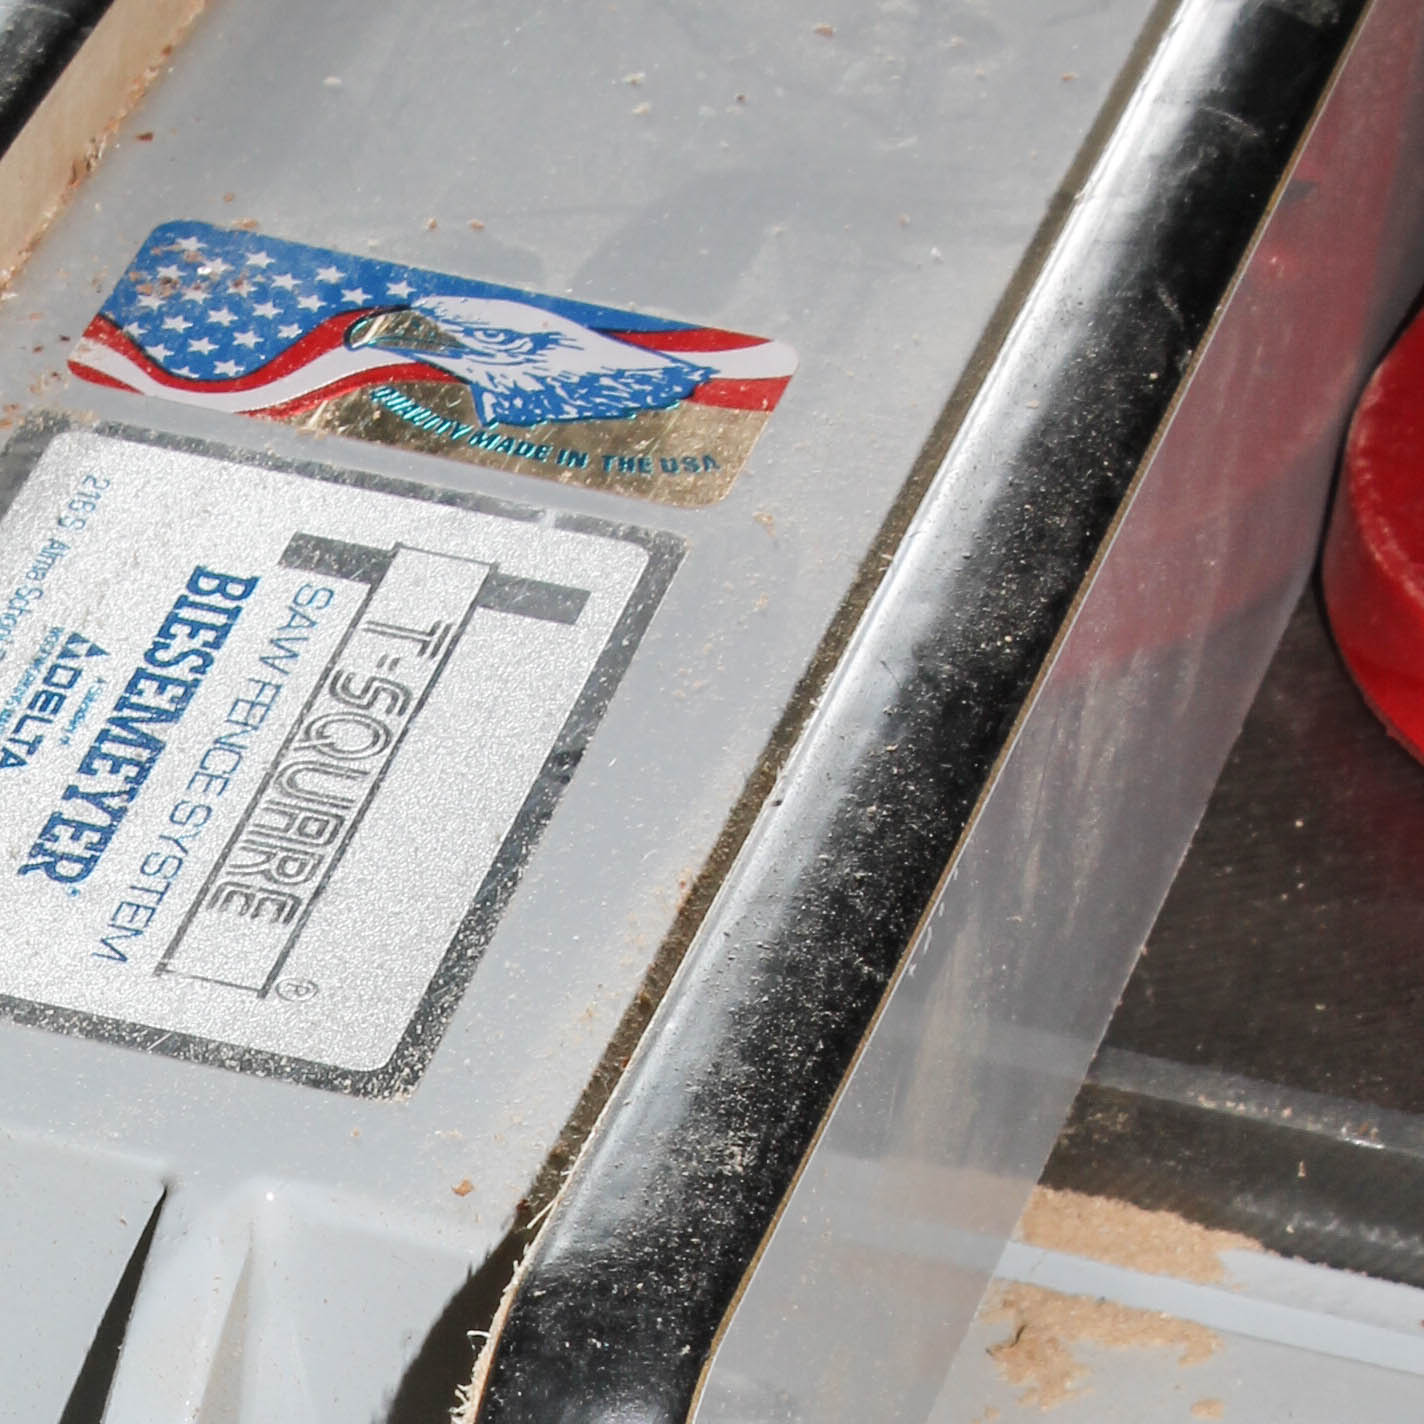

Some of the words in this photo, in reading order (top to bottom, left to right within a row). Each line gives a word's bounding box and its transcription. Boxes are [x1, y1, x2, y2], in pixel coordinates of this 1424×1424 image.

[64, 473, 113, 514] 216
[468, 429, 552, 463] MADE
[555, 448, 590, 469] IN
[601, 453, 654, 476] THE
[659, 453, 721, 475] USA
[22, 536, 74, 583] Alma
[252, 582, 337, 675] SAW
[17, 564, 260, 888] BIESEMEYER
[183, 678, 282, 797] FENCE
[203, 605, 454, 928] T-SQUARE
[89, 798, 212, 963] SYSTEM
